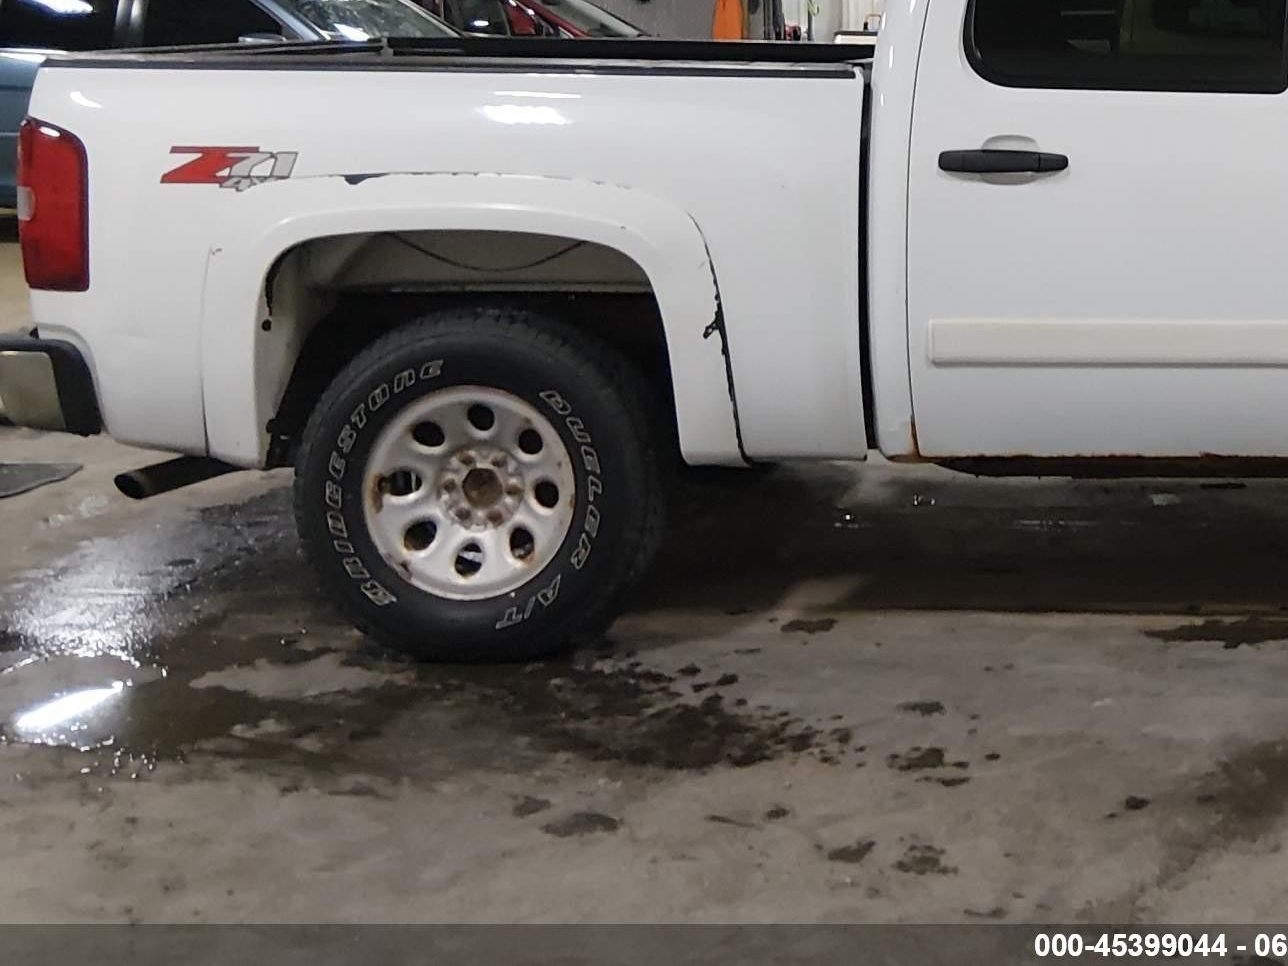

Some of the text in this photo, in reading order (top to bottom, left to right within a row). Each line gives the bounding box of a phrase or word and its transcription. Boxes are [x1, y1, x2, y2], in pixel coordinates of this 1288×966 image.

[159, 145, 299, 184] Z71
[324, 359, 445, 607] BRIDGESTONE
[495, 390, 603, 630] DUELER A/T
